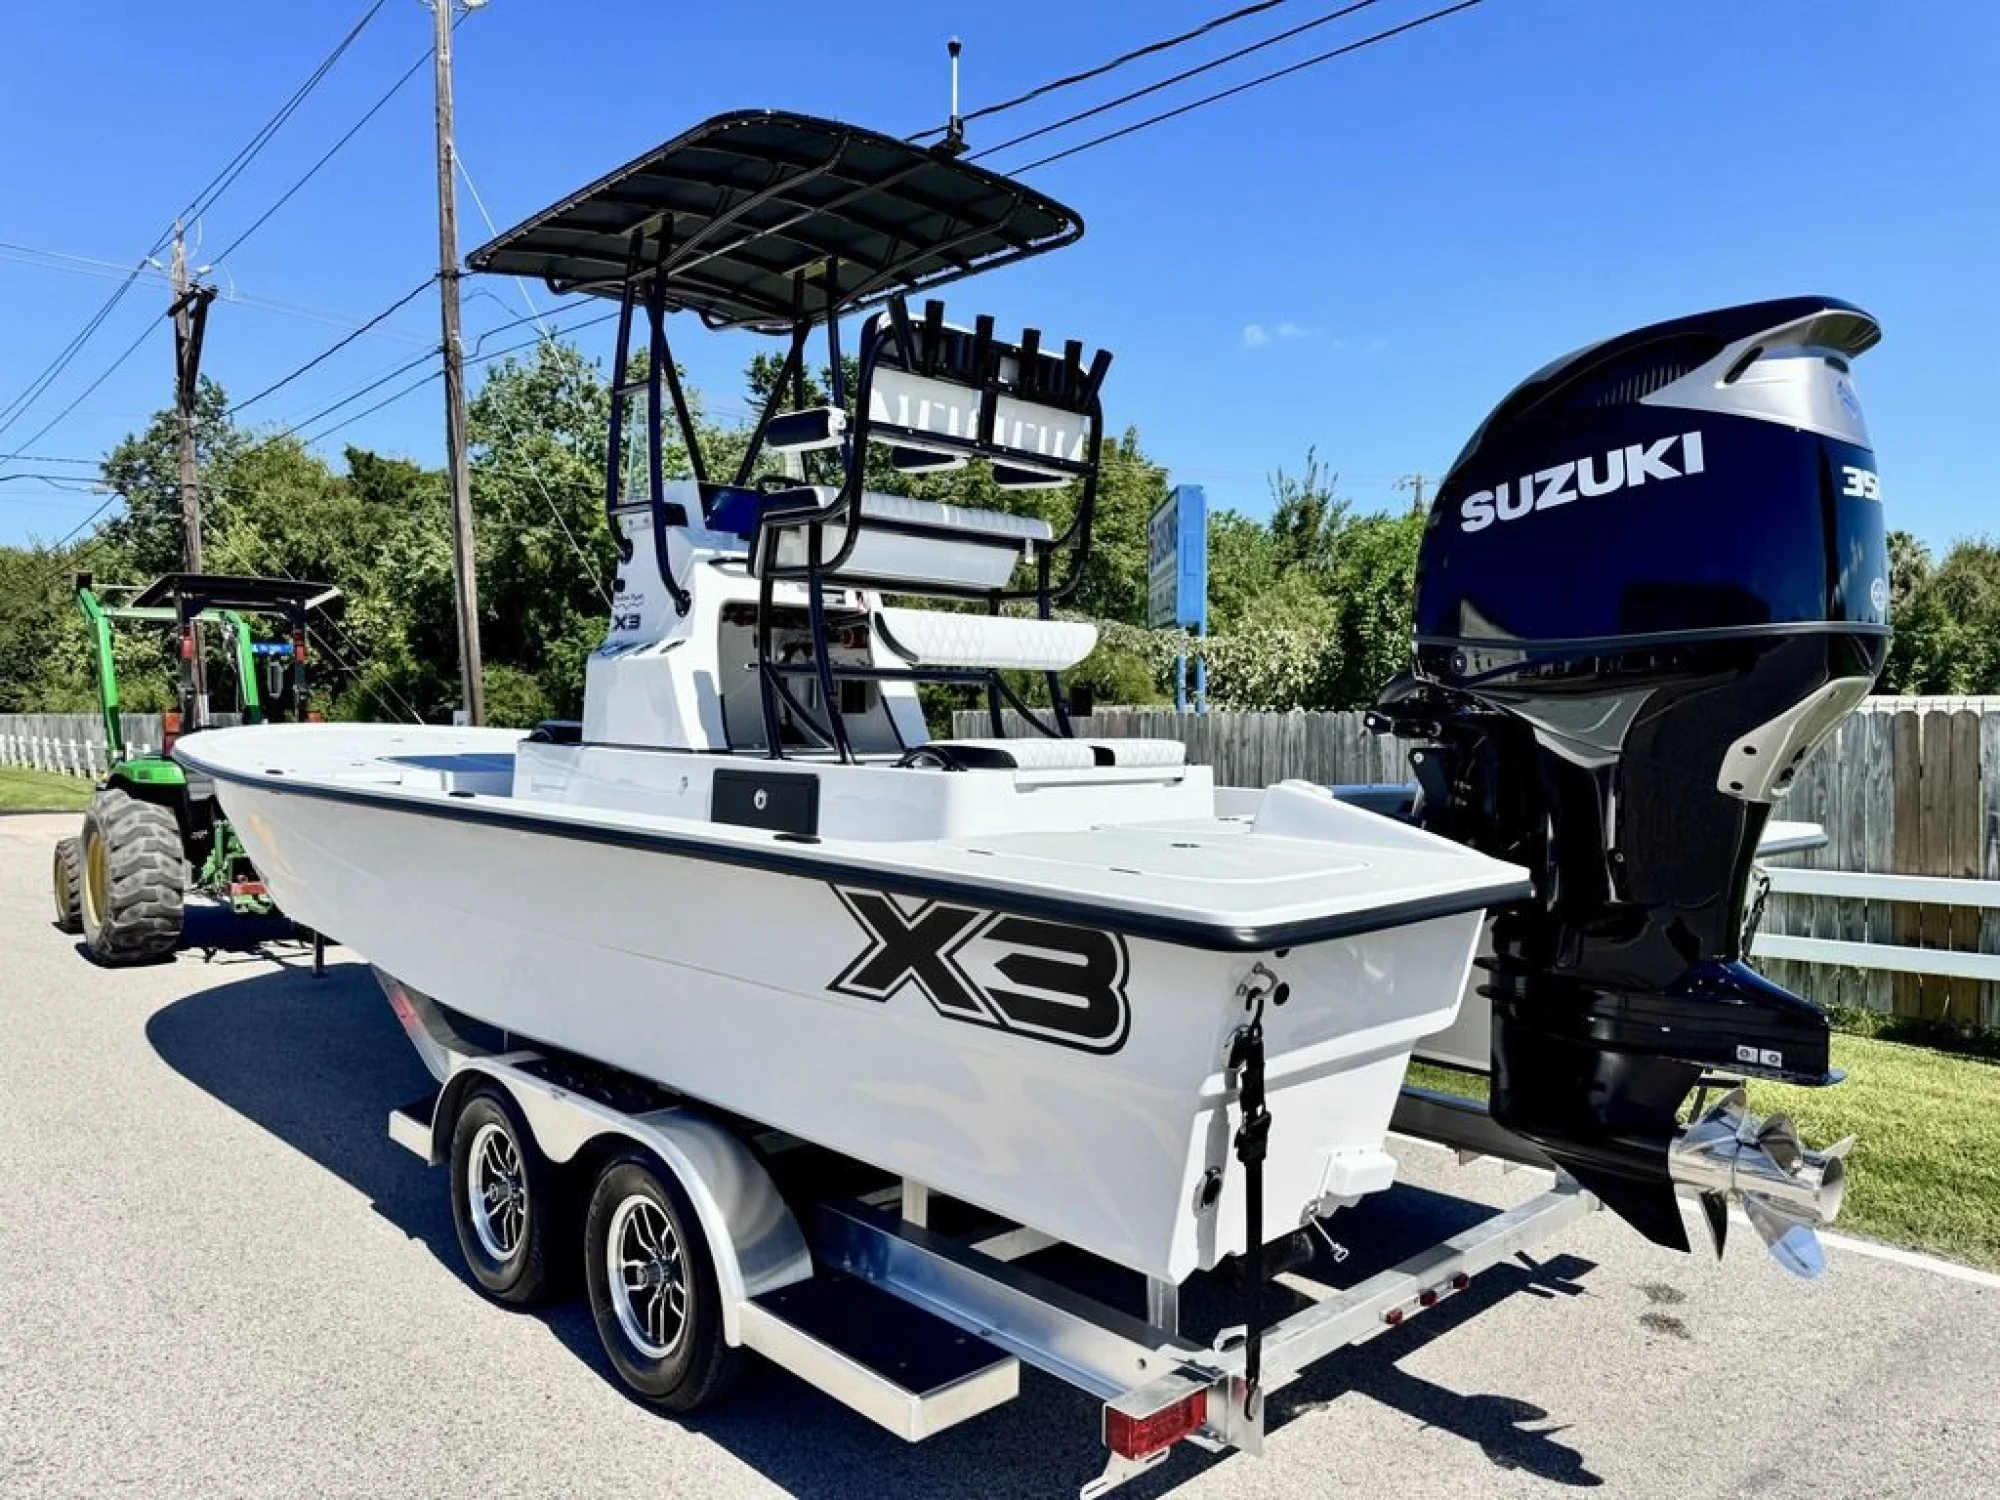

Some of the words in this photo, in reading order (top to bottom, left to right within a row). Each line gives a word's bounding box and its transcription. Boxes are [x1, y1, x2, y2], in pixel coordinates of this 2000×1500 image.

[1460, 430, 1704, 533] SUZUKI
[1842, 465, 1883, 501] 35
[613, 613, 641, 631] X3
[826, 882, 1131, 1055] X3
